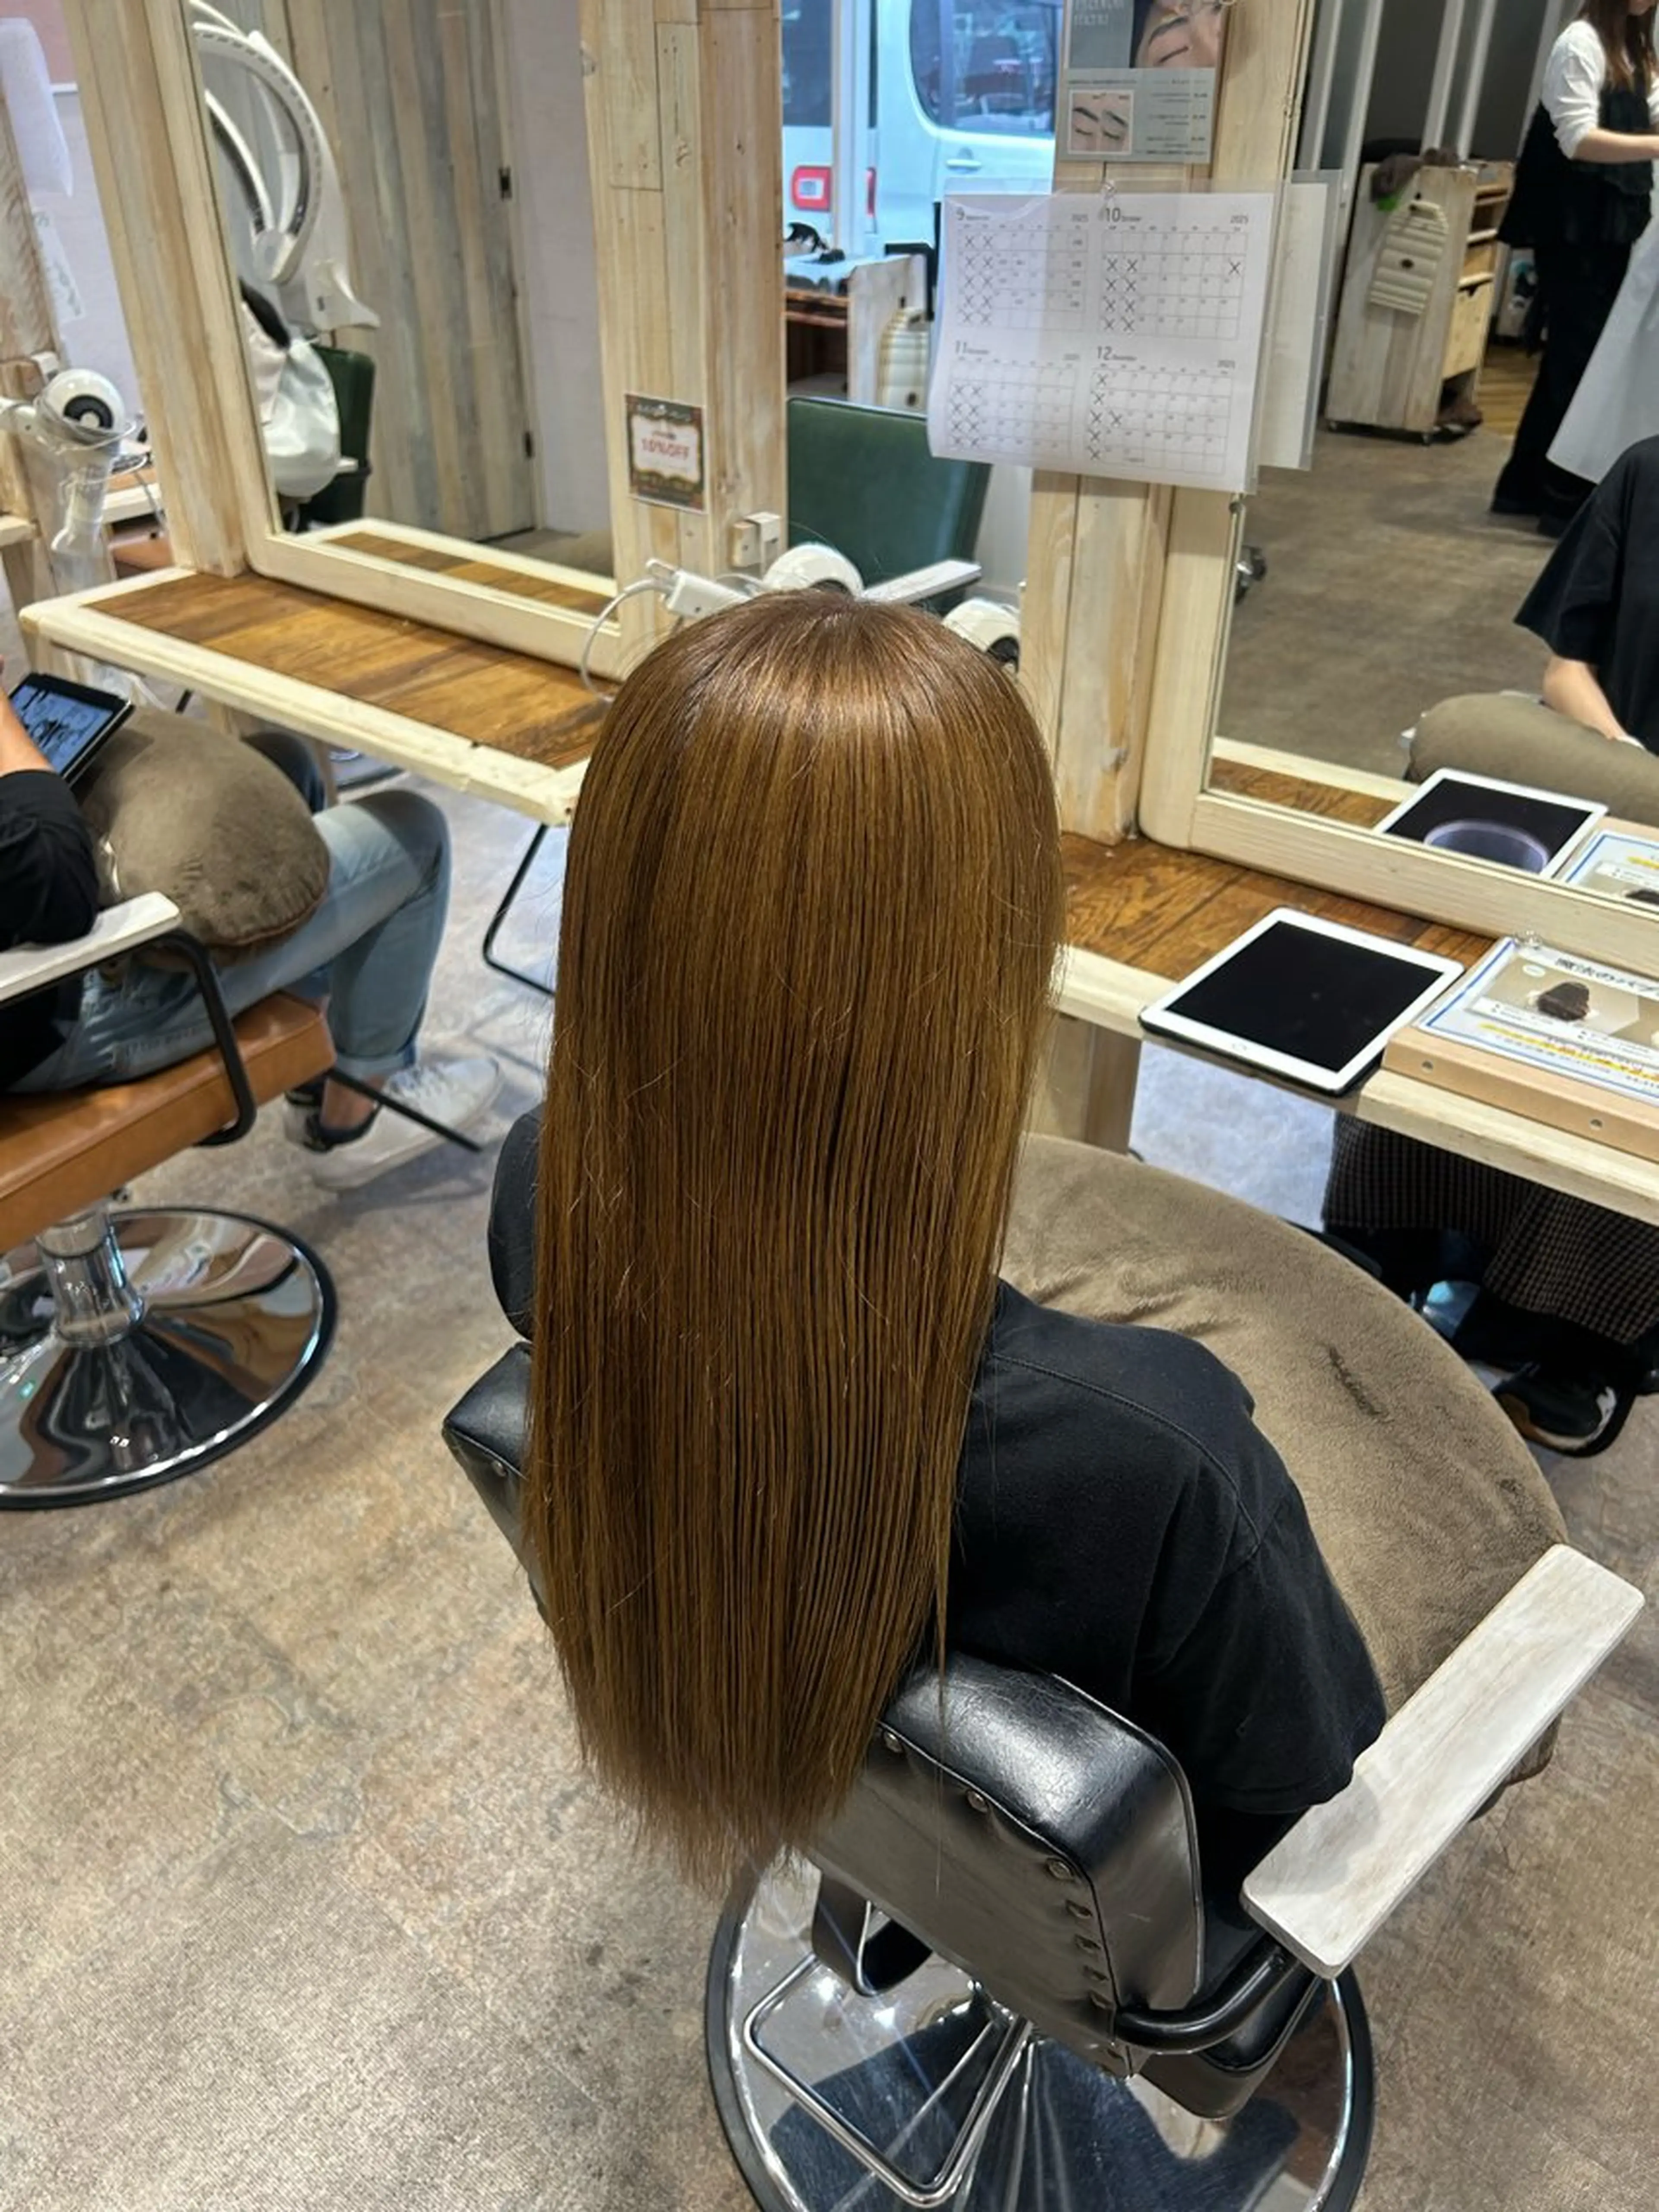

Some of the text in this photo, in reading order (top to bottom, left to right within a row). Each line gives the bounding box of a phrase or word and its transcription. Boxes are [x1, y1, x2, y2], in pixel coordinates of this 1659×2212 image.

[1106, 207, 1121, 222] 10
[955, 340, 967, 354] 11
[1097, 346, 1112, 361] 12
